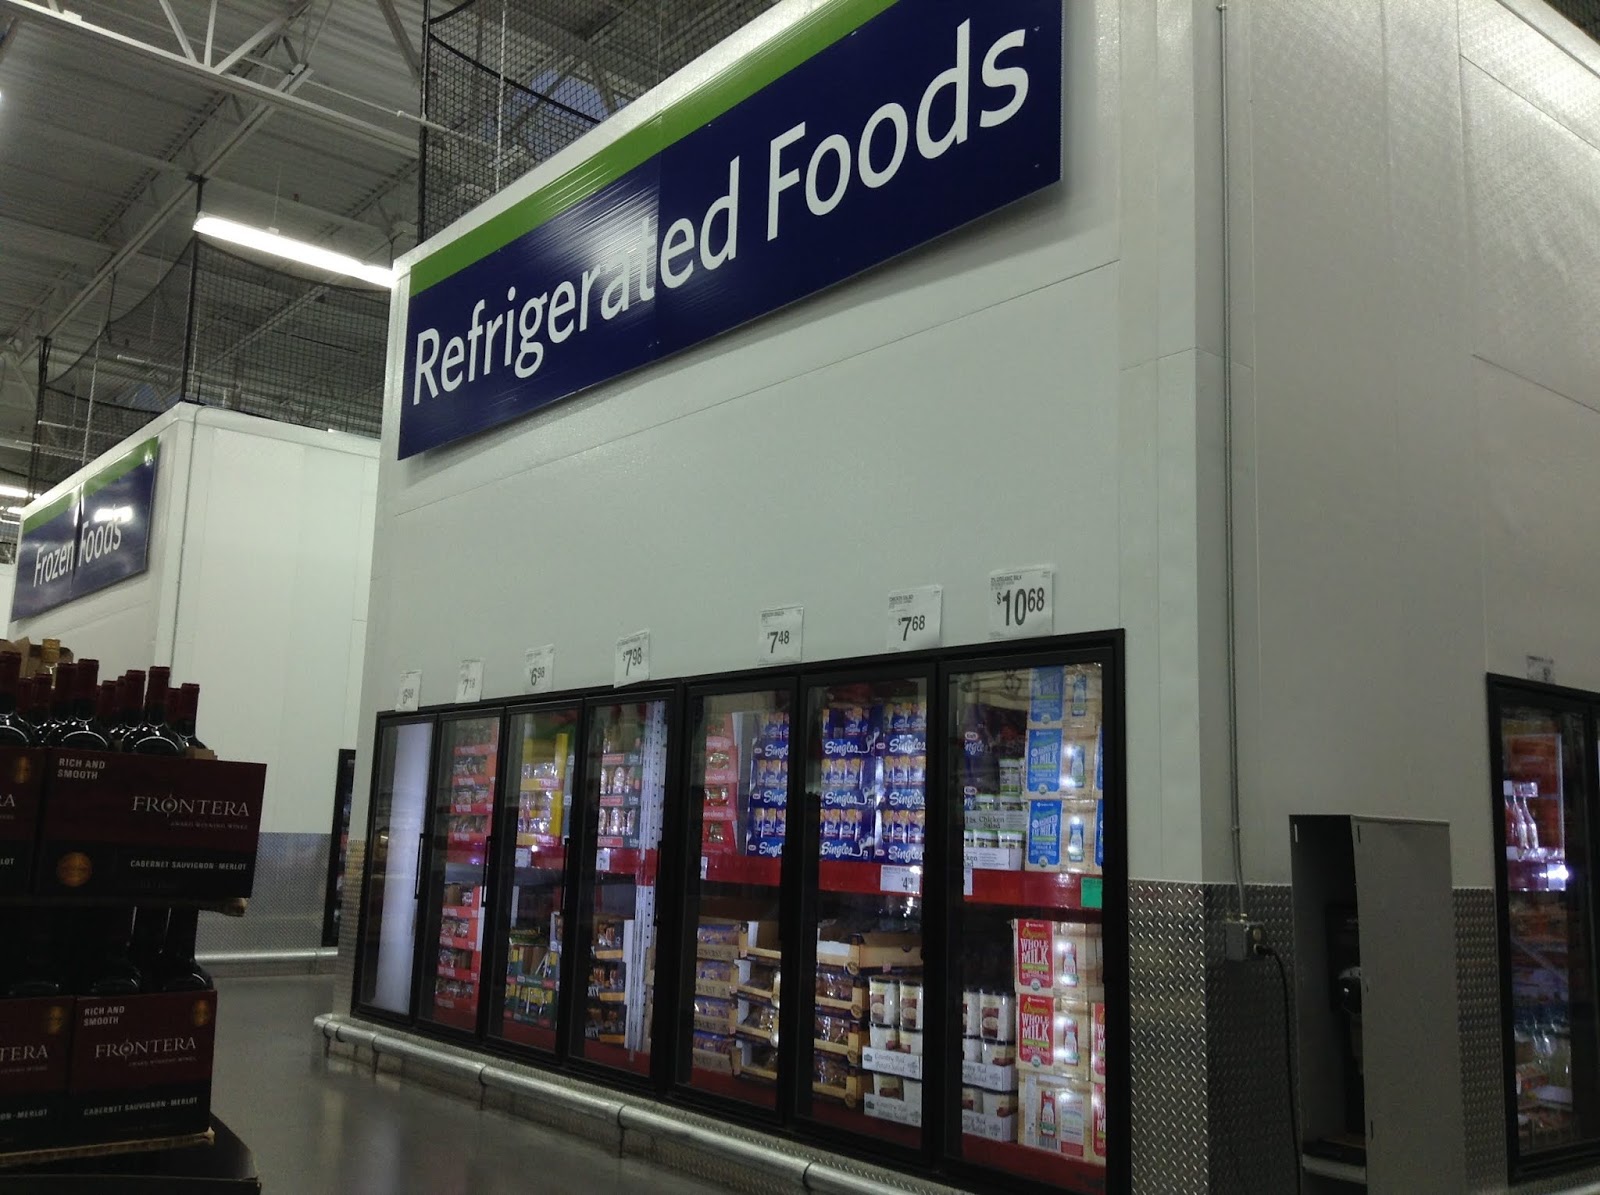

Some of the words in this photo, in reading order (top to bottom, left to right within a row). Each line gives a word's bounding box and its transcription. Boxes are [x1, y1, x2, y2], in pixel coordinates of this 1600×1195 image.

[413, 155, 740, 405] Refrigerated
[767, 18, 1029, 241] Foods
[33, 541, 75, 588] Frozen
[78, 515, 122, 567] Foods
[825, 741, 859, 756] Singles
[889, 738, 926, 755] Singles
[59, 758, 82, 767] RICH
[85, 760, 105, 769] AND
[57, 769, 98, 780] SMOOTH
[132, 794, 250, 818] FRONTERA
[825, 791, 858, 806] Singles
[889, 792, 925, 808] Singles
[821, 841, 854, 857] Singles
[888, 845, 923, 863] Singles
[130, 860, 169, 869] CABERNET
[171, 861, 214, 871] SAUVIGNON
[218, 863, 248, 871] MERLOT
[1020, 938, 1049, 951] WHOLE
[1021, 947, 1049, 965] MILK
[84, 1007, 104, 1016] RICH
[107, 1006, 125, 1014] AND
[83, 1016, 119, 1026] SMOOTH
[1021, 1013, 1049, 1026] WHOLE
[1022, 1024, 1049, 1042] MILK
[95, 1036, 197, 1059] FRONTERA
[17, 1109, 48, 1119] MERLOT
[83, 1104, 122, 1116] CABERNET
[124, 1101, 167, 1111] SAUVIGNON
[170, 1097, 198, 1106] MERLOT
